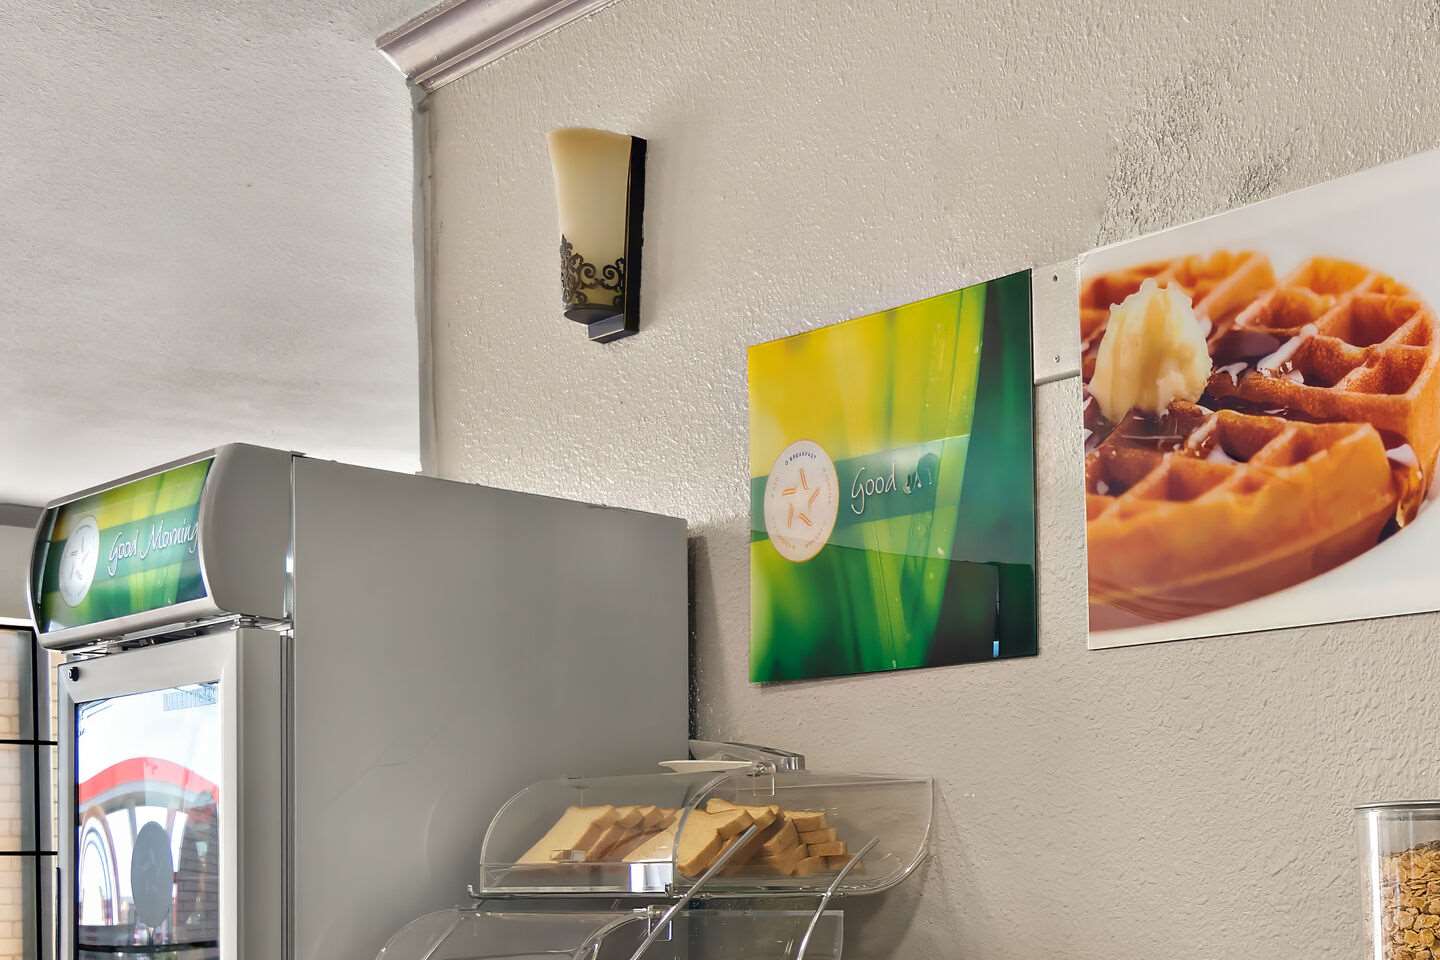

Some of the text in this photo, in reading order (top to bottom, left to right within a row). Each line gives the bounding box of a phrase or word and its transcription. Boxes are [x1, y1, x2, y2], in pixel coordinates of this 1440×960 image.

[851, 463, 897, 515] Good
[107, 518, 200, 577] Good Morning
